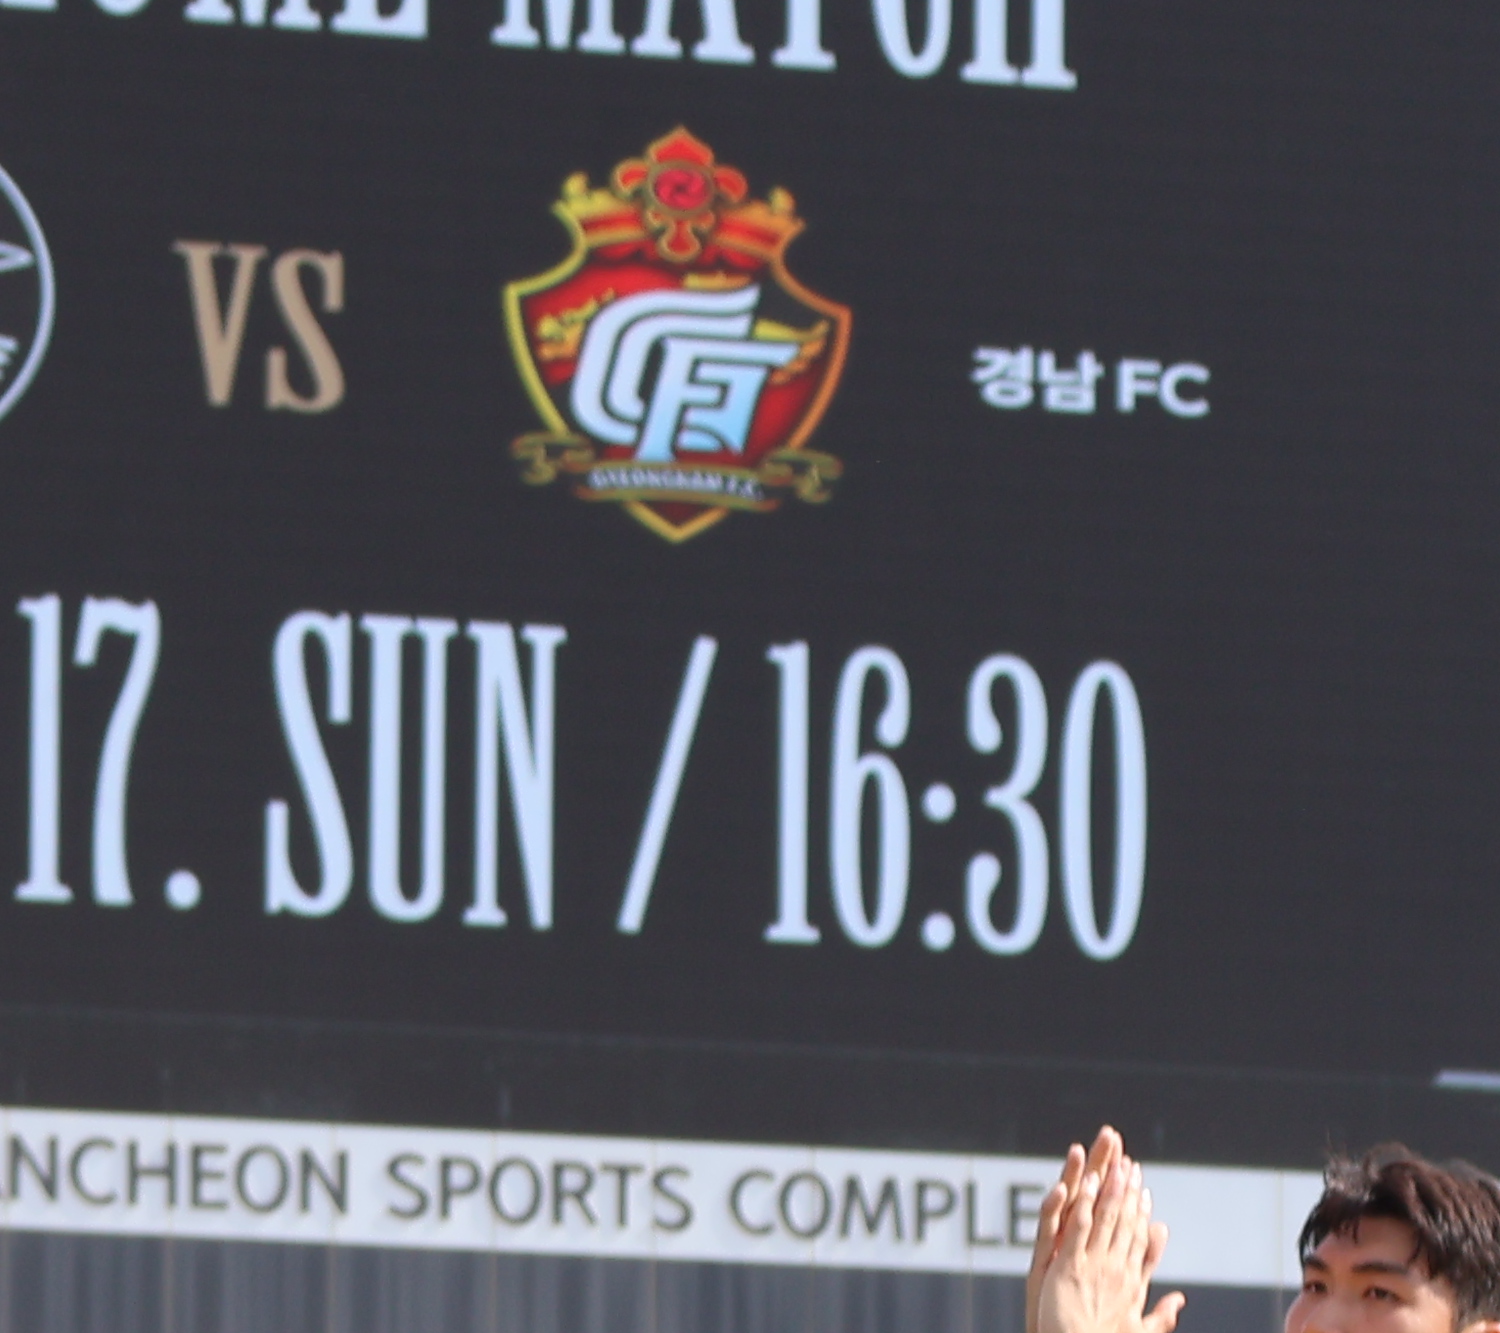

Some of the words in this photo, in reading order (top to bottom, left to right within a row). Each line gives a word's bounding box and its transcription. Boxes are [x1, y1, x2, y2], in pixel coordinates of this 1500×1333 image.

[176, 240, 347, 412] VS
[969, 344, 1105, 415] 경남
[1114, 358, 1211, 419] FC
[16, 594, 203, 911] 17.
[266, 608, 566, 930] SUN
[763, 642, 1149, 962] 16:30
[8, 1133, 350, 1216] NCHEON
[384, 1152, 695, 1233] SPORTS
